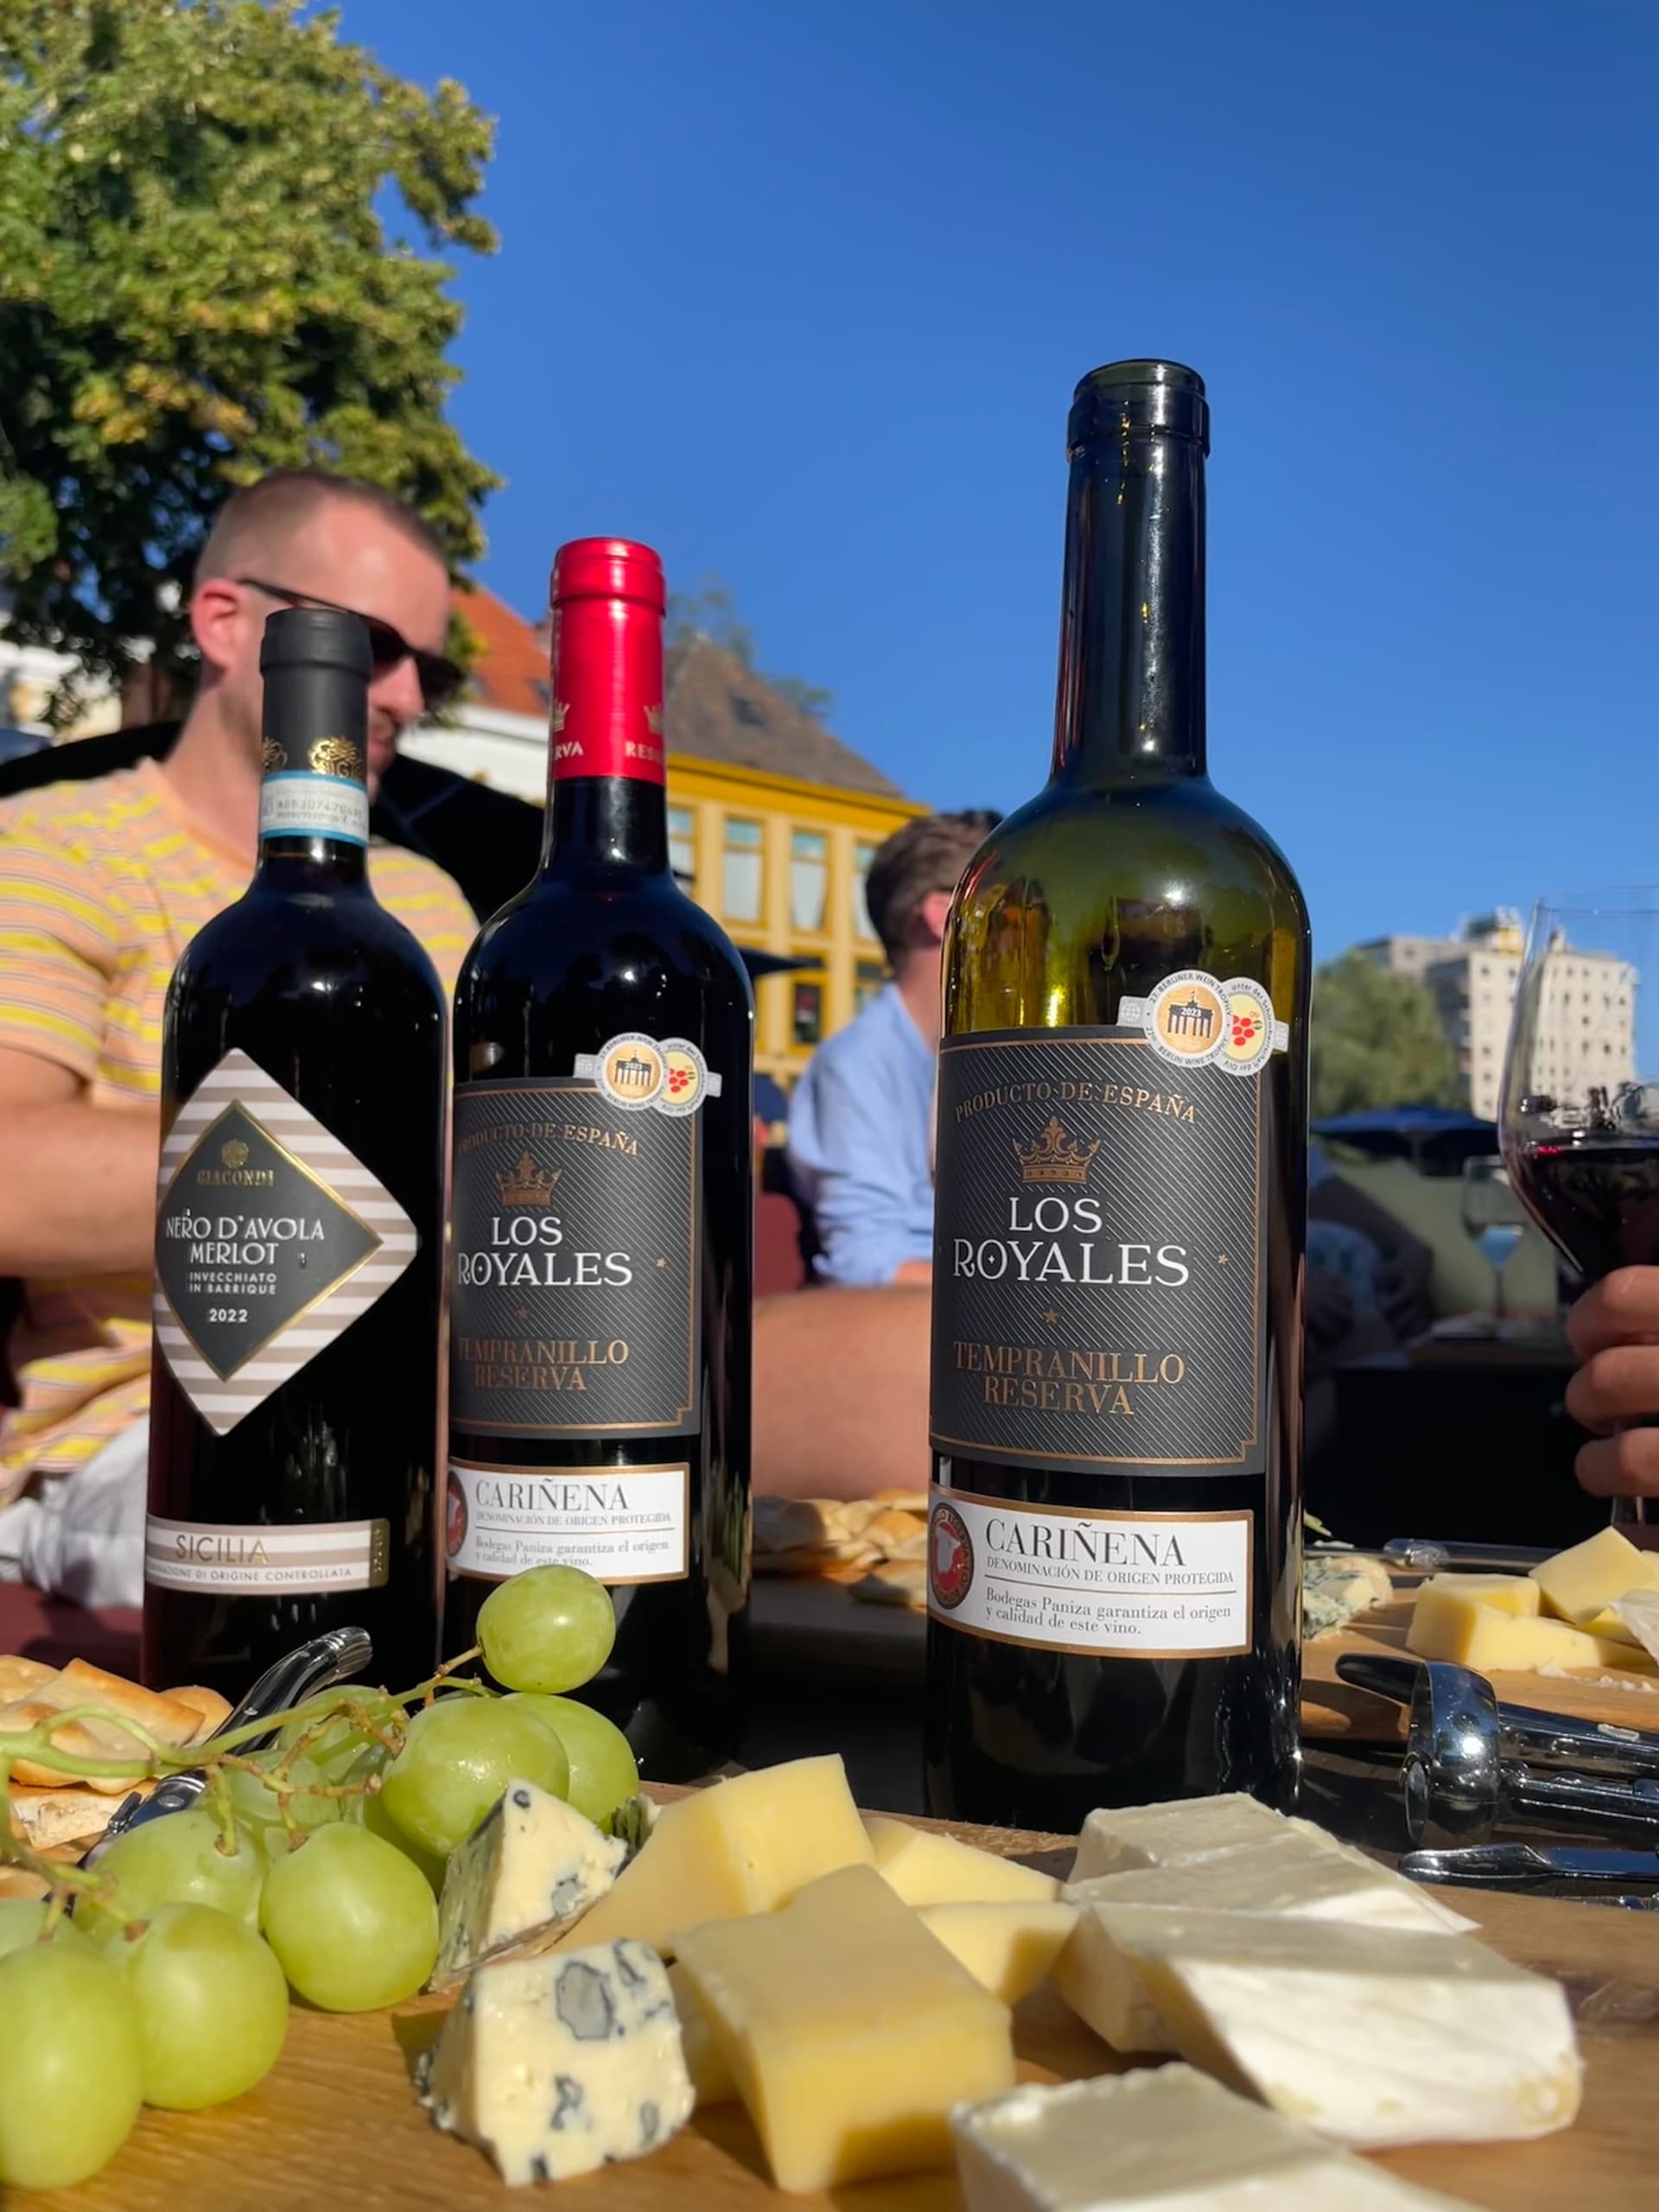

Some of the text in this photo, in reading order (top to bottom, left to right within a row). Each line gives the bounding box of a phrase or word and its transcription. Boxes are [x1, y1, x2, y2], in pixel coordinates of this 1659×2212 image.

[1195, 973, 1216, 987] WEIN
[1215, 985, 1232, 1015] TROPHY
[1181, 1007, 1202, 1017] 2023
[1158, 1046, 1183, 1065] BERLIN
[955, 1083, 1197, 1123] PRODUCTO DE ESPAÑA
[530, 1123, 556, 1139] DE
[564, 1125, 639, 1156] ESPAÑA
[166, 1217, 212, 1239] NERO
[1008, 1197, 1103, 1234] LOS
[492, 1217, 563, 1245] LOS
[190, 1242, 279, 1265] MERLOT
[953, 1238, 1190, 1287] ROYALES
[189, 1271, 277, 1283] INVECCHIATO
[457, 1252, 632, 1287] ROYALES
[189, 1283, 276, 1295] IN BARRIQUE
[209, 1307, 248, 1323] 2022
[953, 1341, 1186, 1384] TEMPRANILLO
[475, 1366, 588, 1391] RESERVA
[983, 1376, 1135, 1415] RESERVA
[476, 1478, 630, 1511] CARIÑENA
[547, 1514, 561, 1526] DE
[565, 1514, 607, 1526] ORIGEN
[611, 1512, 671, 1525] PROTEGIDA
[175, 1534, 270, 1565] SICILIA
[515, 1541, 553, 1554] Paniza
[556, 1541, 614, 1556] garantiza
[618, 1538, 629, 1552] el
[632, 1541, 670, 1554] origen
[986, 1518, 1186, 1567] CARIÑENA
[211, 1571, 258, 1581] ORIGINE
[264, 1567, 353, 1582] CONTROLLATA
[987, 1556, 1234, 1585] DENOMINACIÓN DE ORIGEN PROTEGIDA
[986, 1588, 1231, 1622] Bodegas Paniza garantiza el origen
[996, 1607, 1043, 1626] calidad
[1048, 1613, 1065, 1628] de
[1070, 1619, 1098, 1634] este
[1104, 1621, 1141, 1635] vino.
